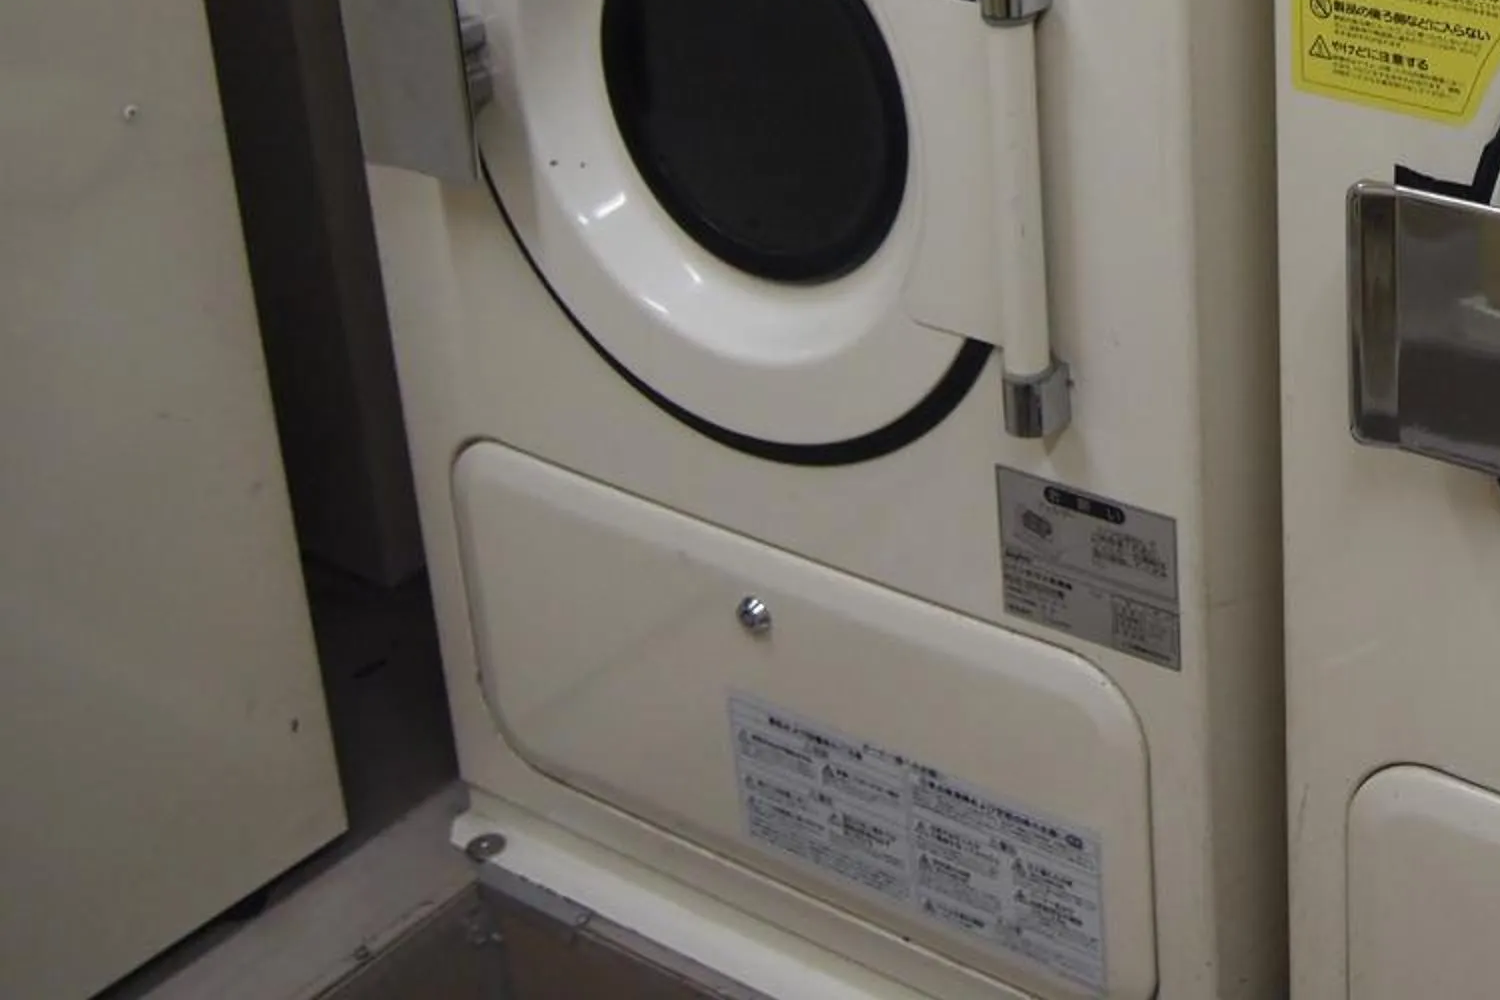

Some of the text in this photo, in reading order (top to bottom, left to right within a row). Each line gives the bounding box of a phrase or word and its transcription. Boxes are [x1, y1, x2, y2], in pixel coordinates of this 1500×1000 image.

[1333, 38, 1429, 72] やけどに注意する
